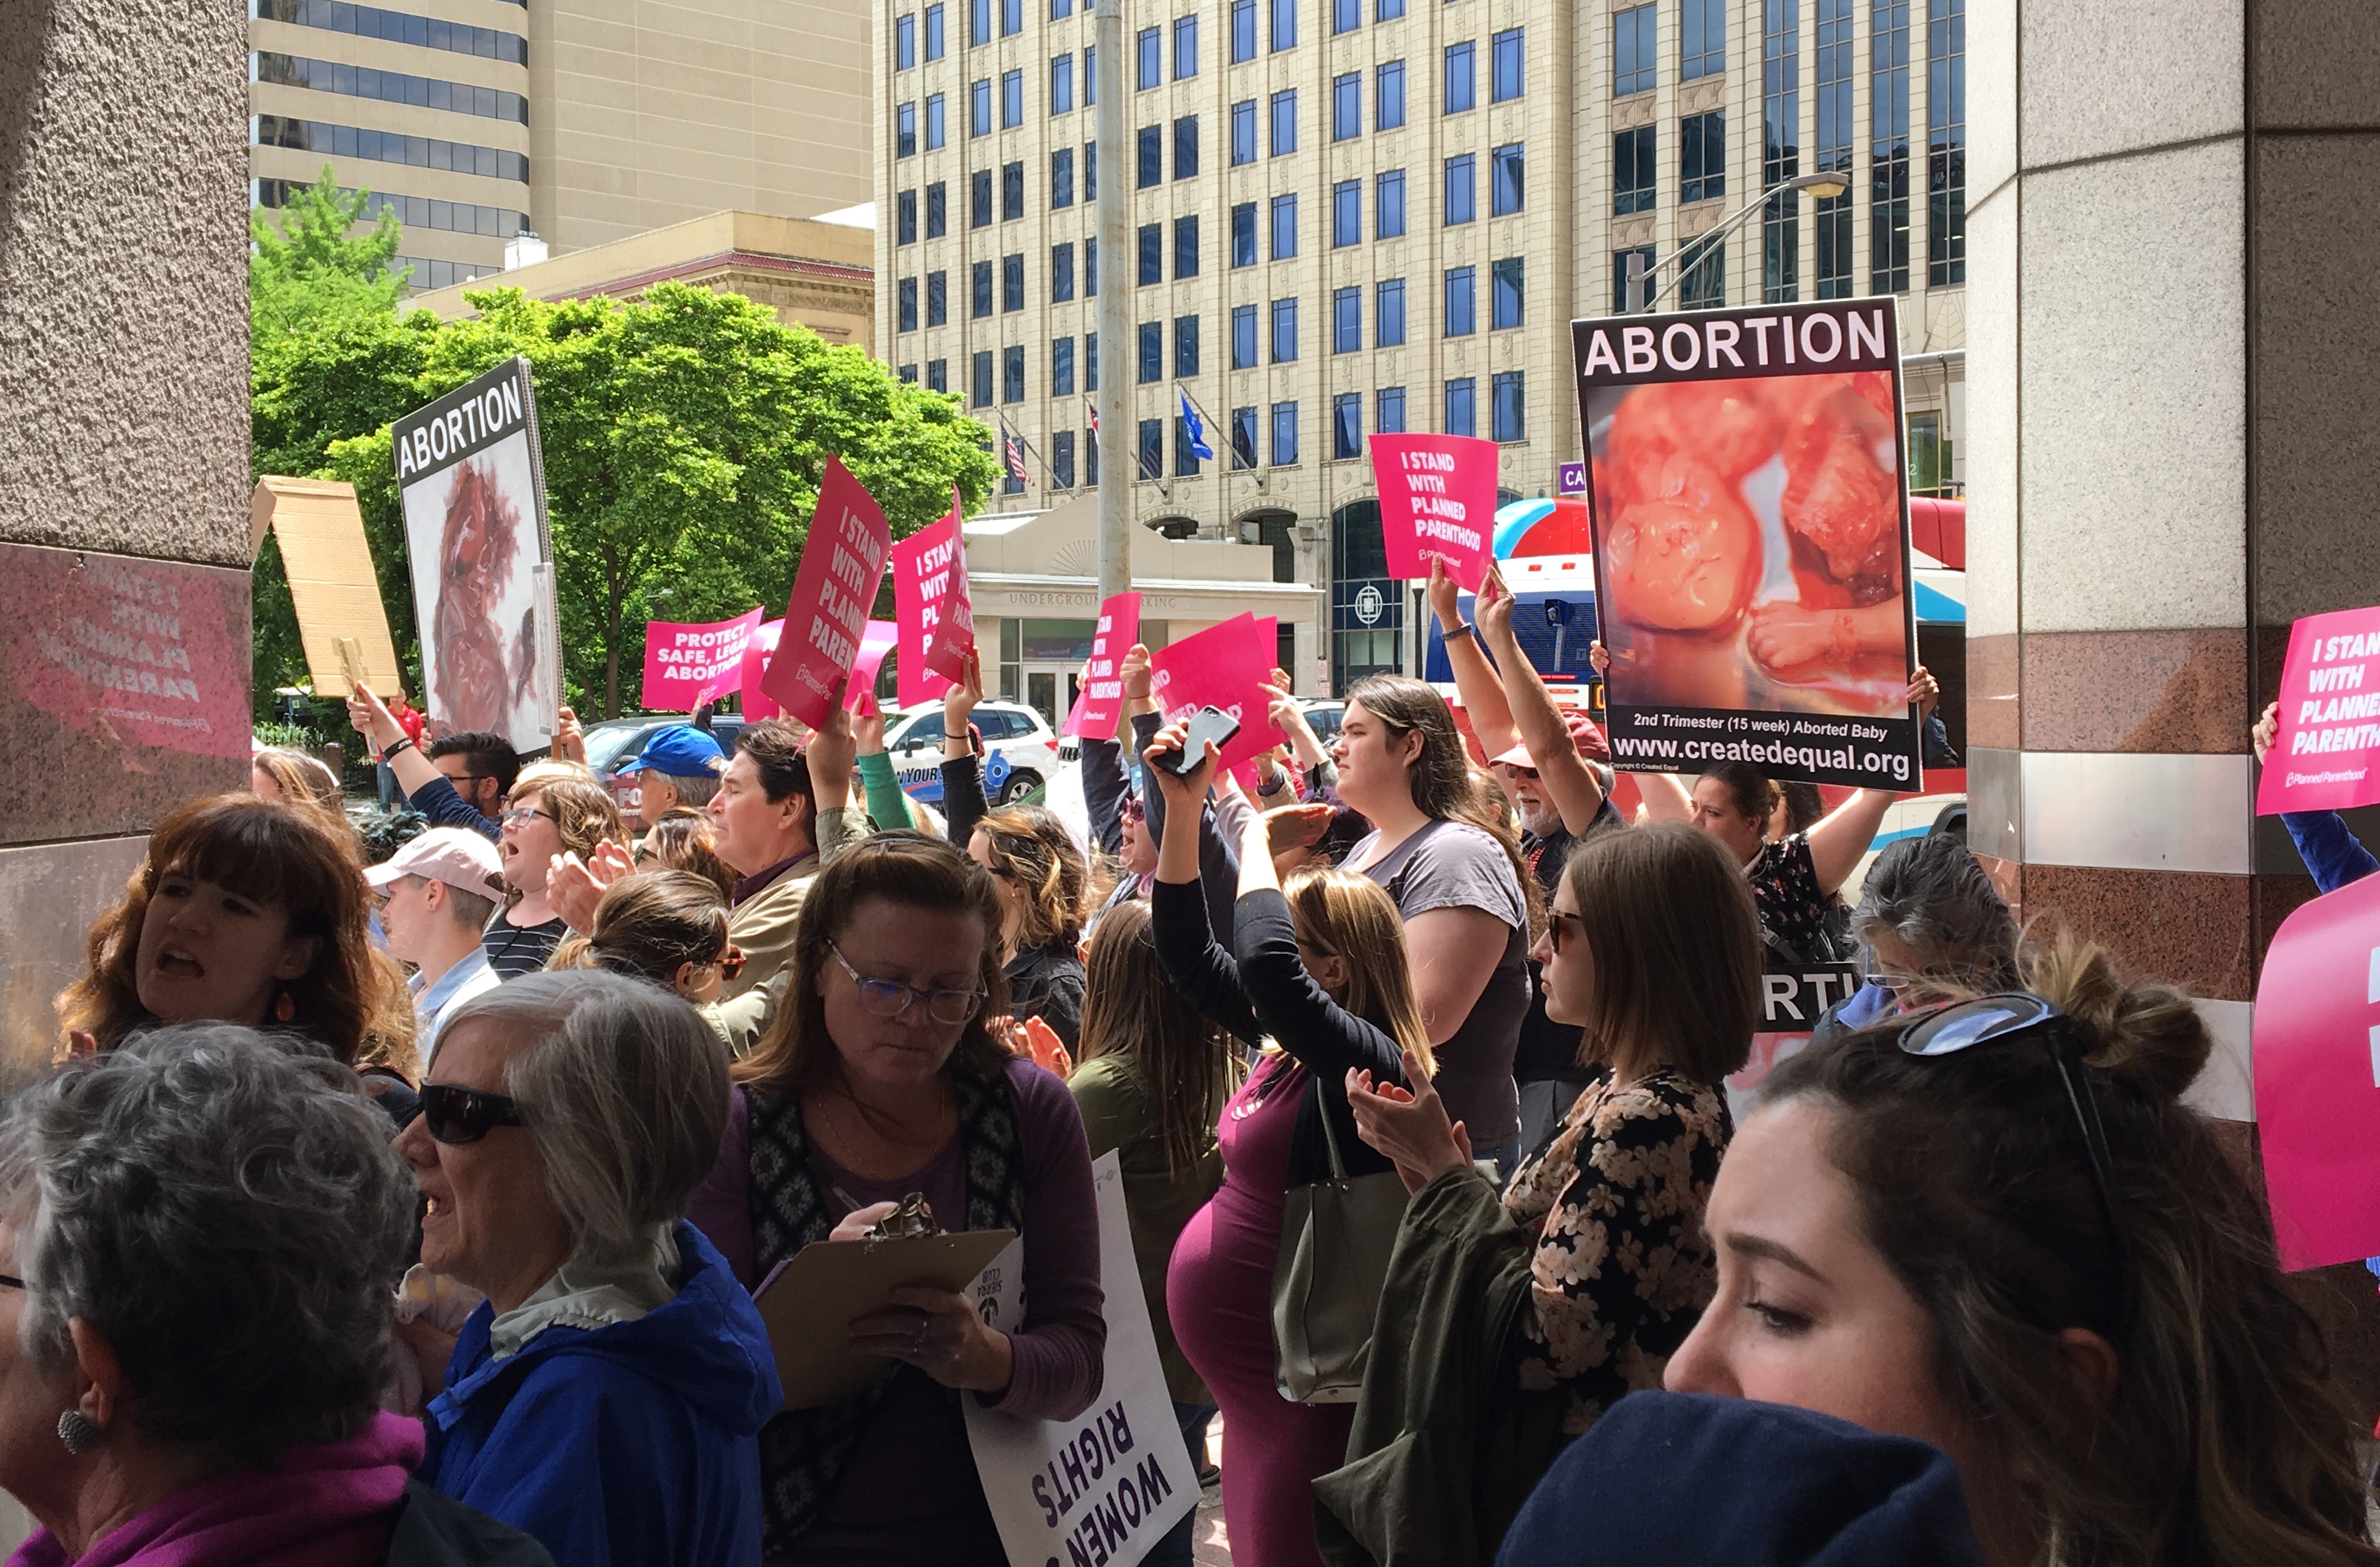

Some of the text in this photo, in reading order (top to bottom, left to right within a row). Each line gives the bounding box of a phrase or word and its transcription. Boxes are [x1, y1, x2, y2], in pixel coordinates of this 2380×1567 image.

[1584, 309, 1887, 377] ABORTION
[400, 375, 522, 478] ABORTION
[1401, 452, 1455, 472] I STAND
[1406, 475, 1446, 493] WITH
[1565, 470, 1584, 486] CA
[1411, 496, 1466, 521] PLANNED
[839, 505, 881, 573] I STAND
[1415, 519, 1480, 552] PARENTHOOD
[831, 542, 866, 597] WITH
[916, 556, 923, 577] I
[675, 622, 747, 647] PROTECT
[657, 648, 711, 666] SAFE,
[2312, 639, 2322, 662] I
[663, 652, 743, 681] ABORTION
[2309, 665, 2365, 693] WITH
[2299, 692, 2380, 725] PLANNE
[1634, 714, 1888, 742] 2nd Trimester (15 week) Aborted Baby
[985, 748, 1011, 787] 6
[1614, 737, 1909, 781] www.createdequal.org
[907, 767, 937, 783] YOUR
[2293, 768, 2366, 785] Planned Parenthood
[978, 1280, 1003, 1298] SIERRA
[982, 1268, 1001, 1284] CLUB
[1032, 1401, 1134, 1528] RIGHTS
[1045, 1452, 1173, 1567] WOMEN
